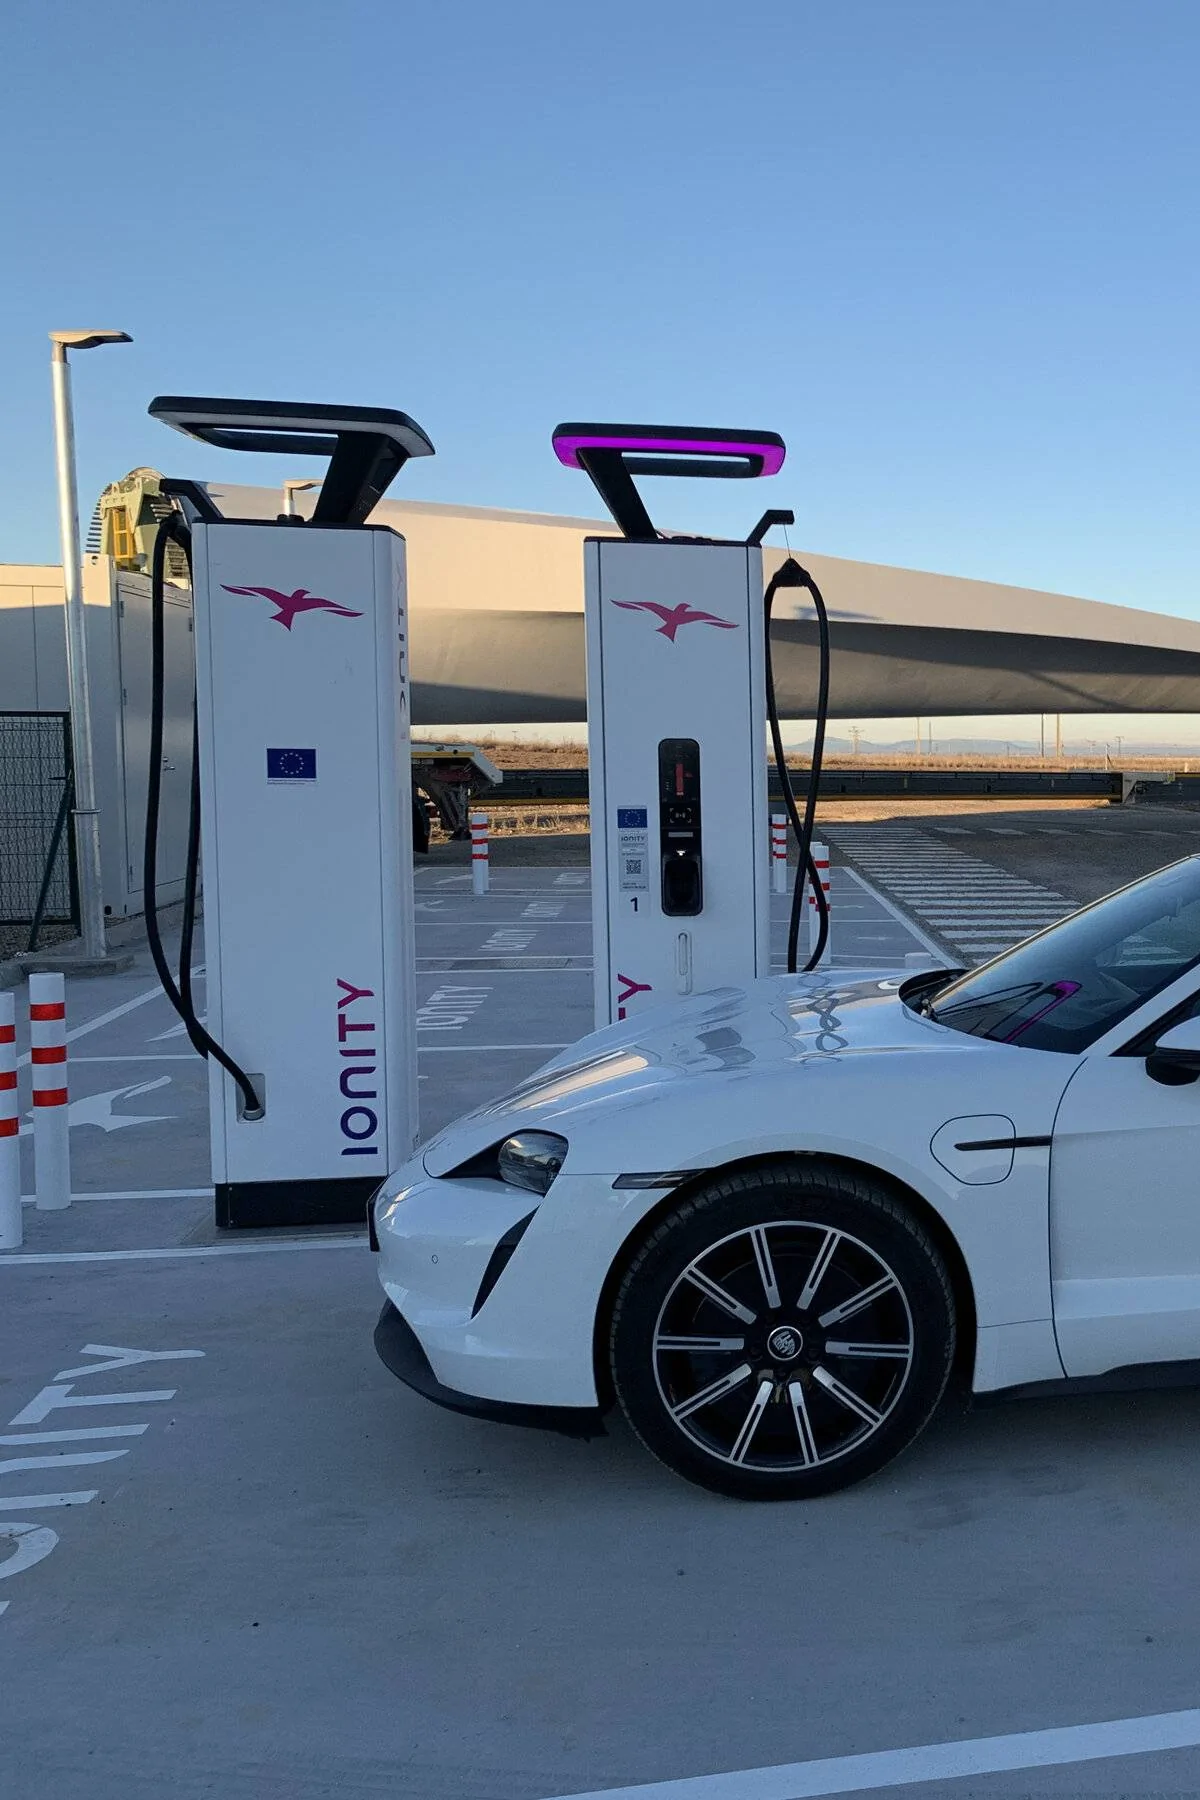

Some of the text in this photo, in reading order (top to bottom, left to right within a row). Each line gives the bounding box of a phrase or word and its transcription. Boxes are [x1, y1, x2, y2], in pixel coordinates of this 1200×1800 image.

[630, 896, 638, 913] 1
[416, 984, 494, 1031] IONITY
[336, 978, 378, 1156] IONITY
